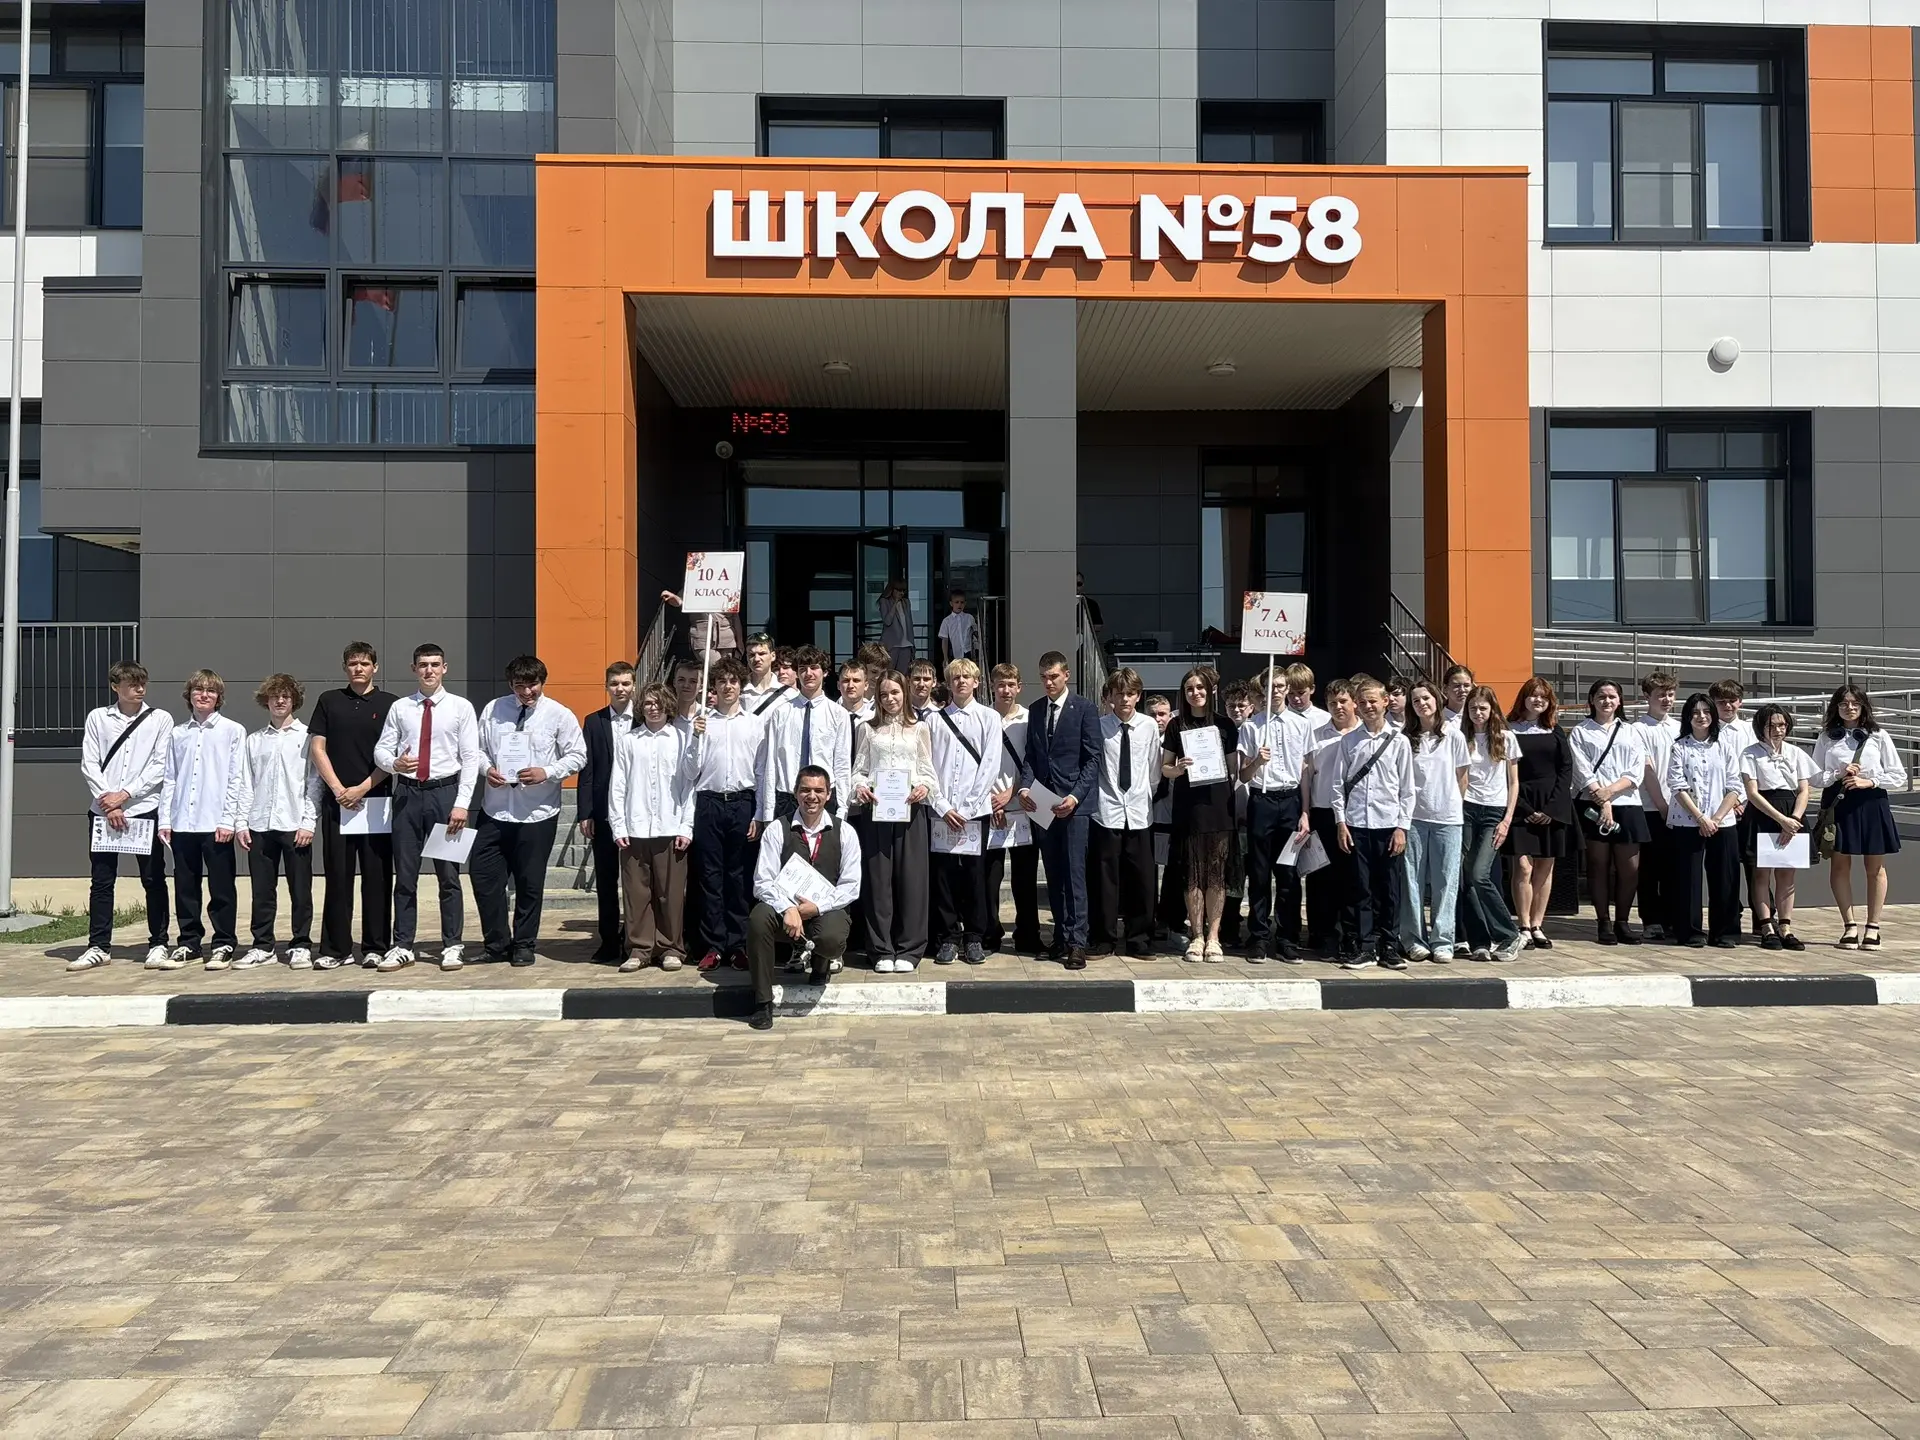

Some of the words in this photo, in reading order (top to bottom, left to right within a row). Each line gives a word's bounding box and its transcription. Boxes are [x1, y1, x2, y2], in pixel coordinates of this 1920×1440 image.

[712, 190, 1107, 260] ШКОЛА
[1139, 193, 1363, 264] №58
[697, 568, 714, 581] 10
[718, 568, 730, 581] А
[694, 588, 730, 597] КЛАСС
[1261, 608, 1271, 622] 7
[1274, 609, 1288, 622] А
[1254, 629, 1294, 639] КЛАСС
